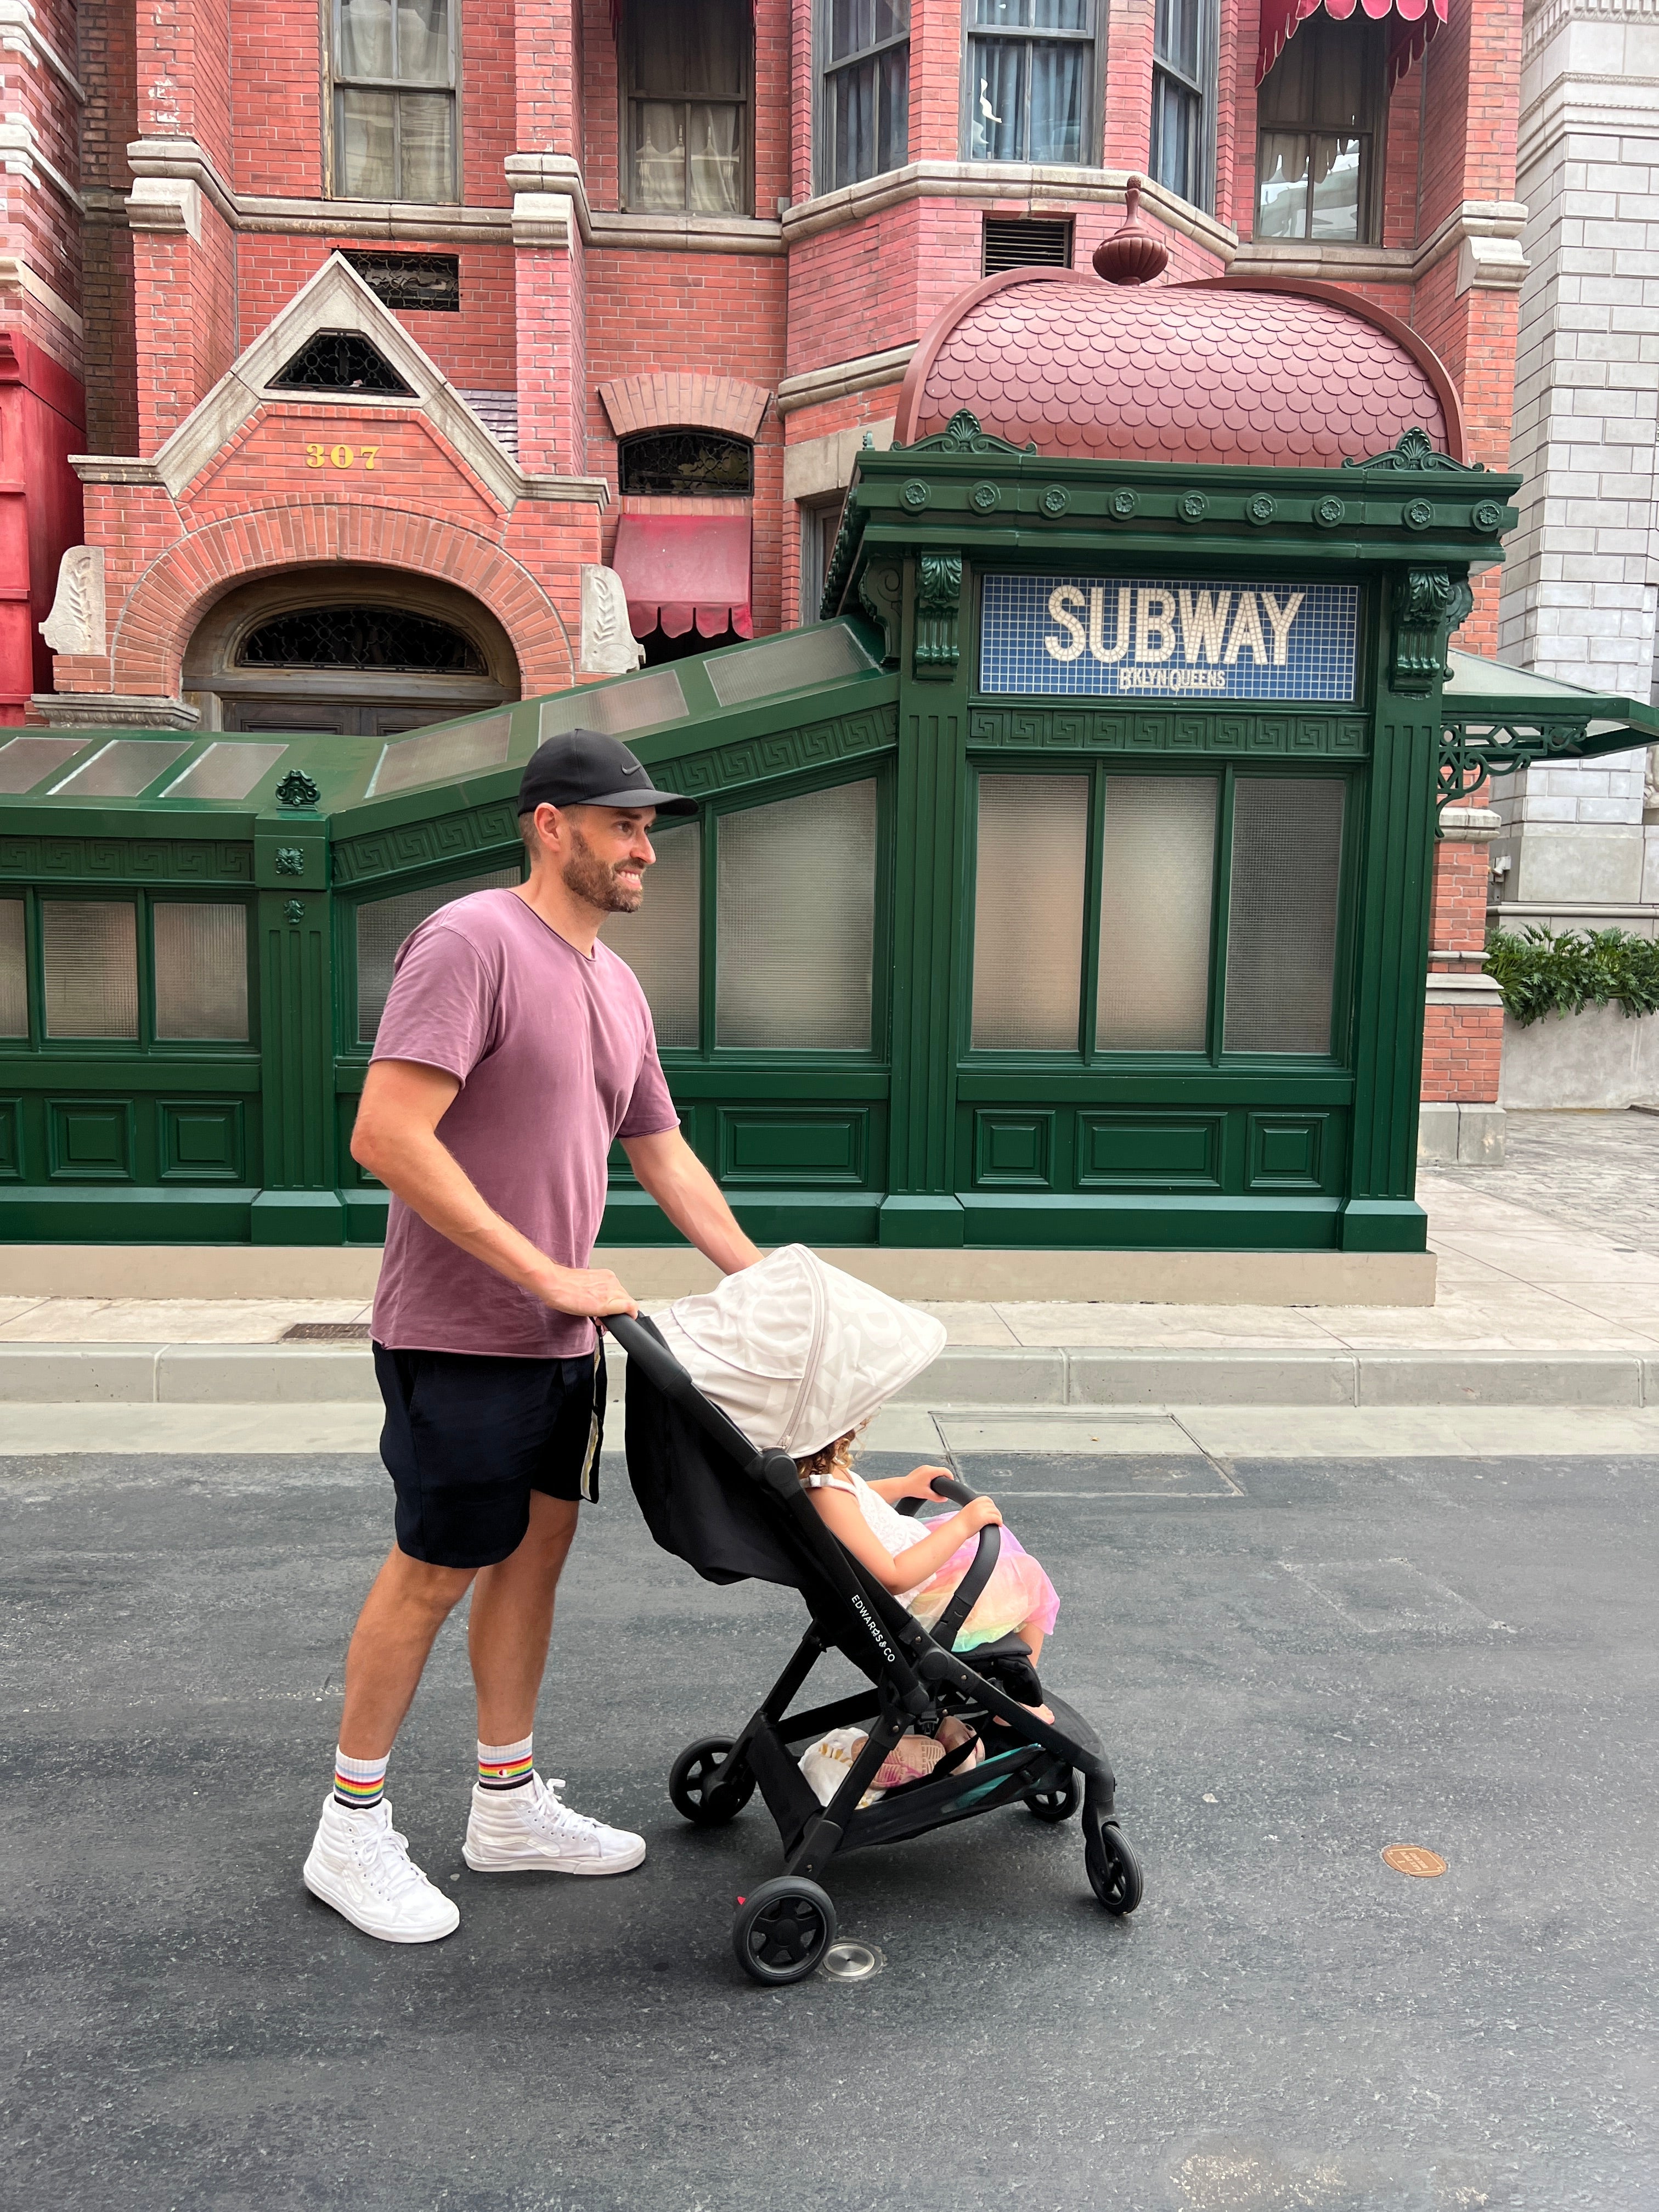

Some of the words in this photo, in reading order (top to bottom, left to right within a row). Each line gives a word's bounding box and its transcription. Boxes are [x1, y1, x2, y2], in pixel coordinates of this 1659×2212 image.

[306, 443, 380, 470] 307
[1044, 584, 1306, 665] SUBWAY
[1169, 669, 1226, 692] QUEENS
